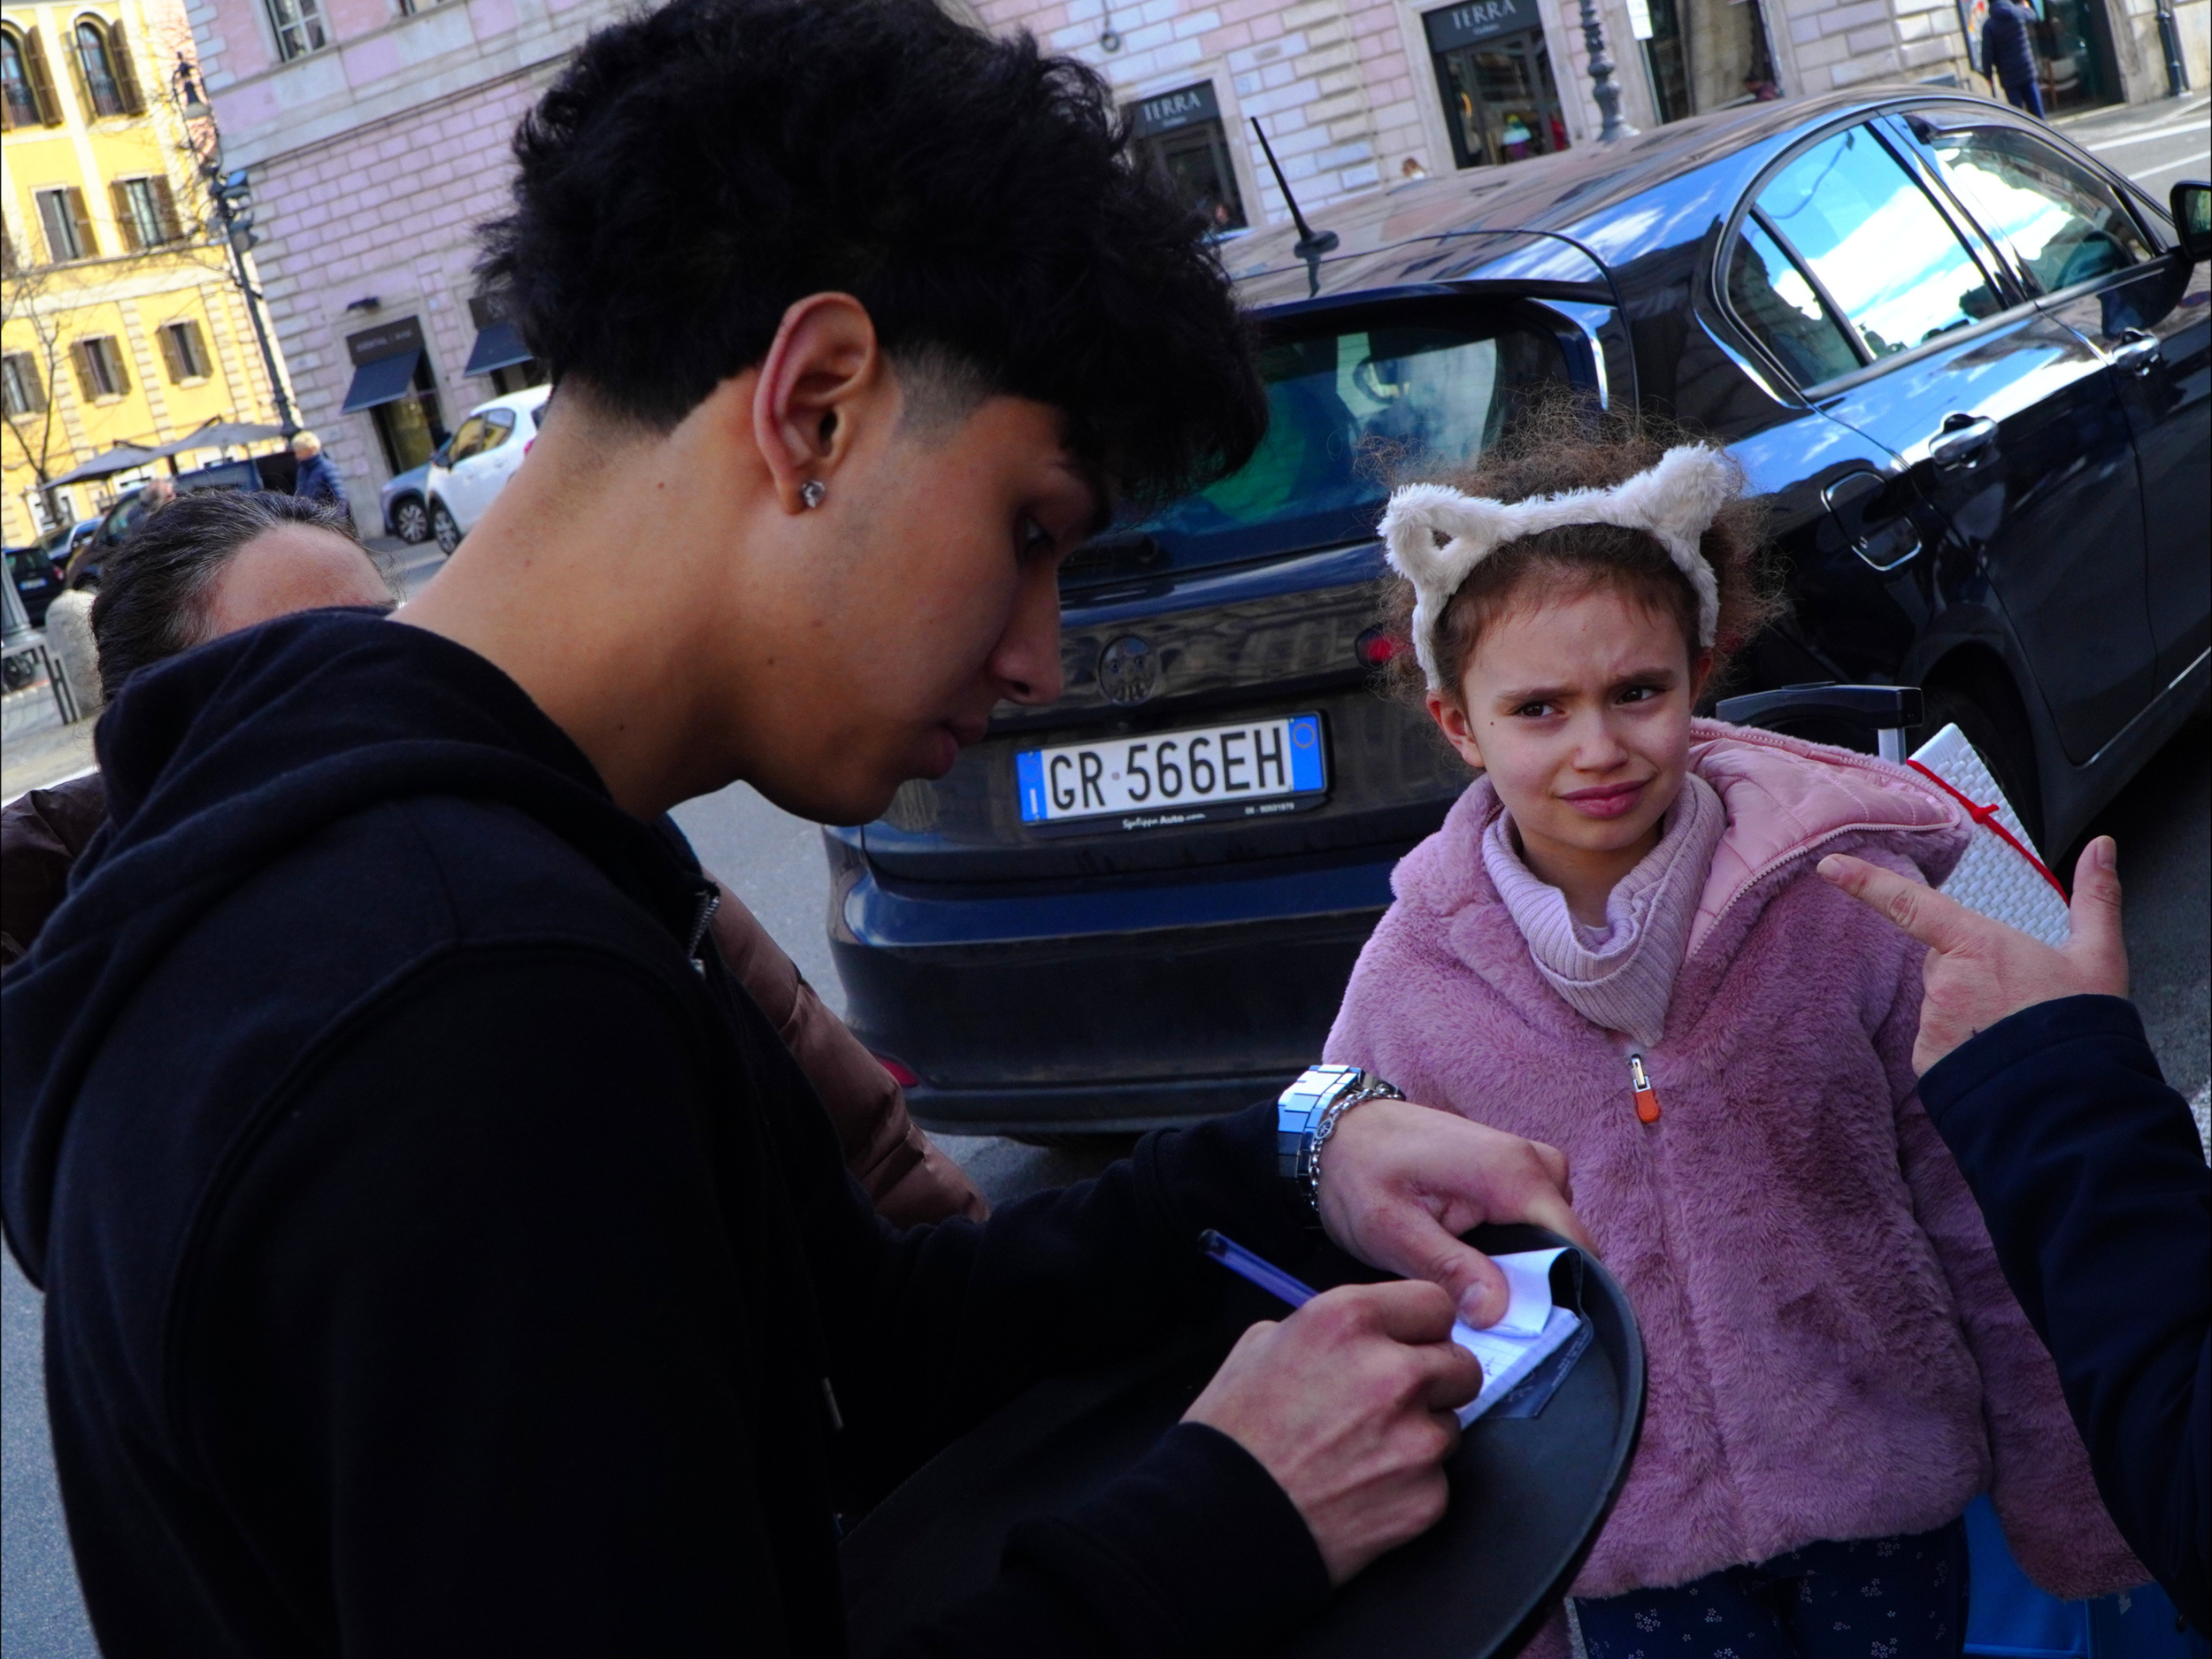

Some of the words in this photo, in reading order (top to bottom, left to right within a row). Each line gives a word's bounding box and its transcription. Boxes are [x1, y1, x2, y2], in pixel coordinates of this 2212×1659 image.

[1452, 0, 1517, 30] TERRA
[1142, 91, 1202, 122] TERRA
[1050, 750, 1106, 810] GR
[1126, 726, 1285, 802] 566EH
